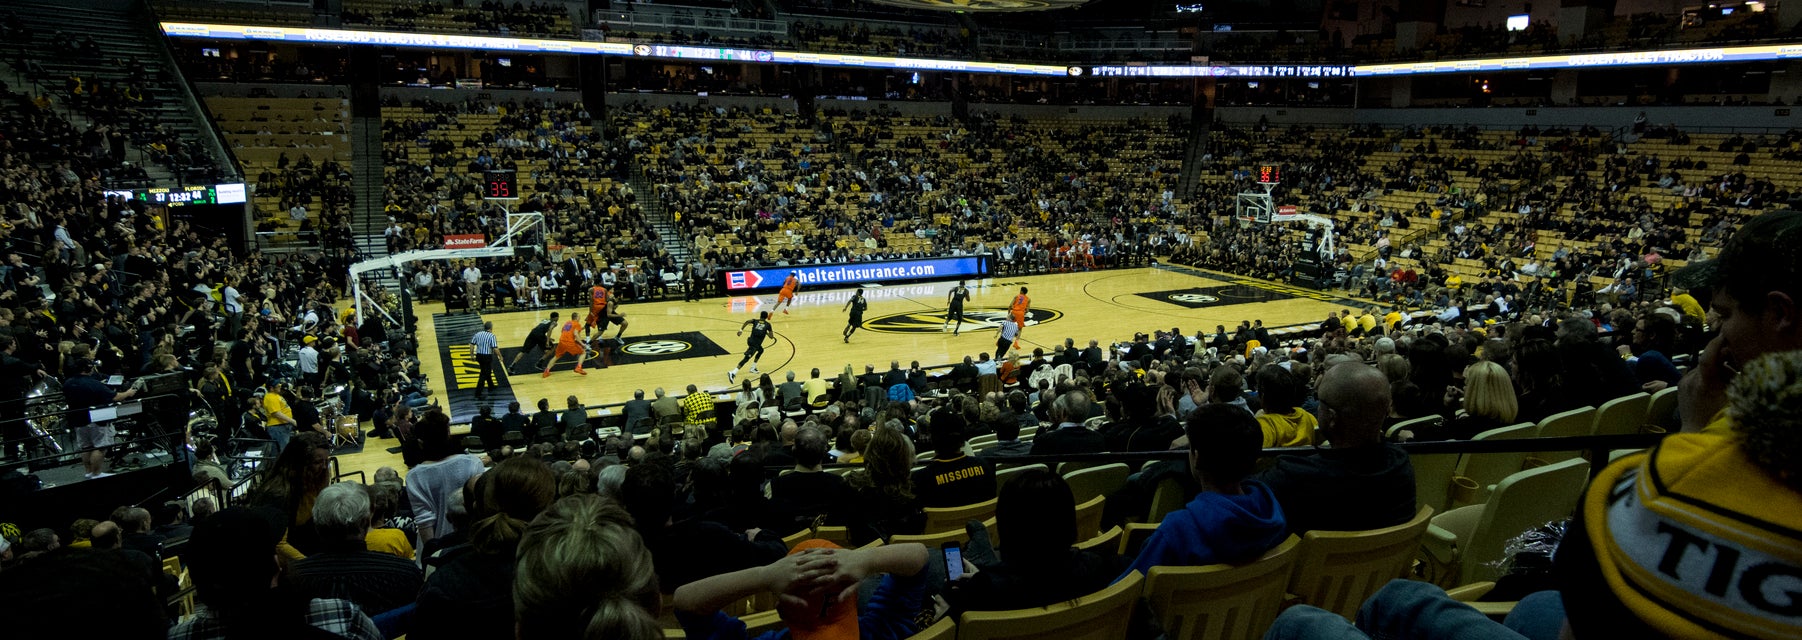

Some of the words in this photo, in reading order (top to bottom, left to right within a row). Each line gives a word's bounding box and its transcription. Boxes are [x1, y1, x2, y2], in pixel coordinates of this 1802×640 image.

[155, 192, 166, 202] 37
[192, 190, 202, 199] 44
[490, 181, 509, 197] 35
[168, 192, 191, 203] 12:32
[791, 265, 935, 284] ShelterInsurance.com
[935, 465, 985, 486] MISSOURI
[1656, 521, 1802, 618] TIG
